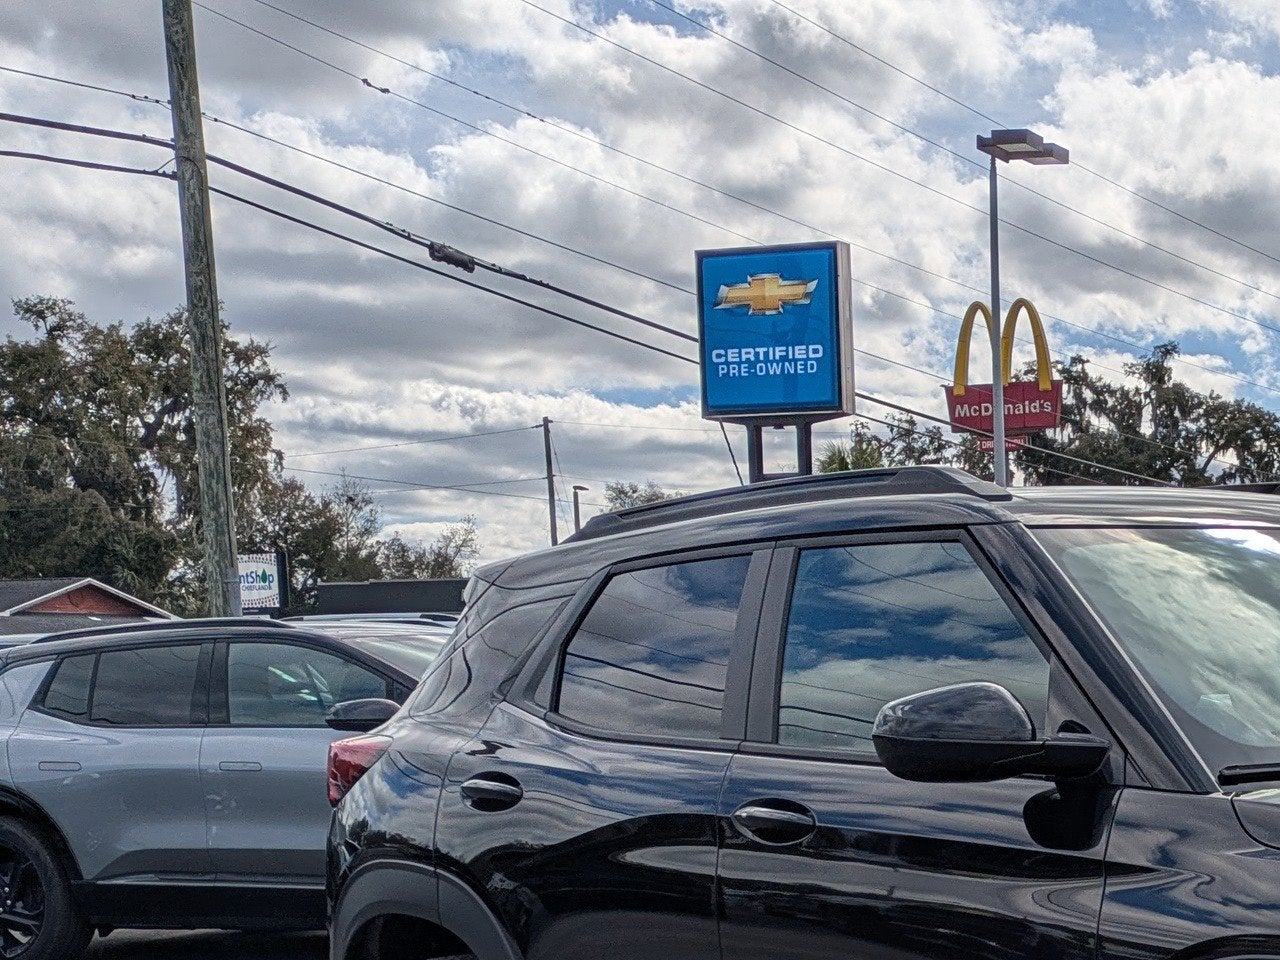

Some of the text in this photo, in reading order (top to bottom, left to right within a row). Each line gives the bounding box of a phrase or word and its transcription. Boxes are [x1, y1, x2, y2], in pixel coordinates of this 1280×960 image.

[711, 344, 824, 363] CERTIFIED
[718, 360, 817, 377] PRE-OWNED
[954, 400, 1052, 418] McDnald's
